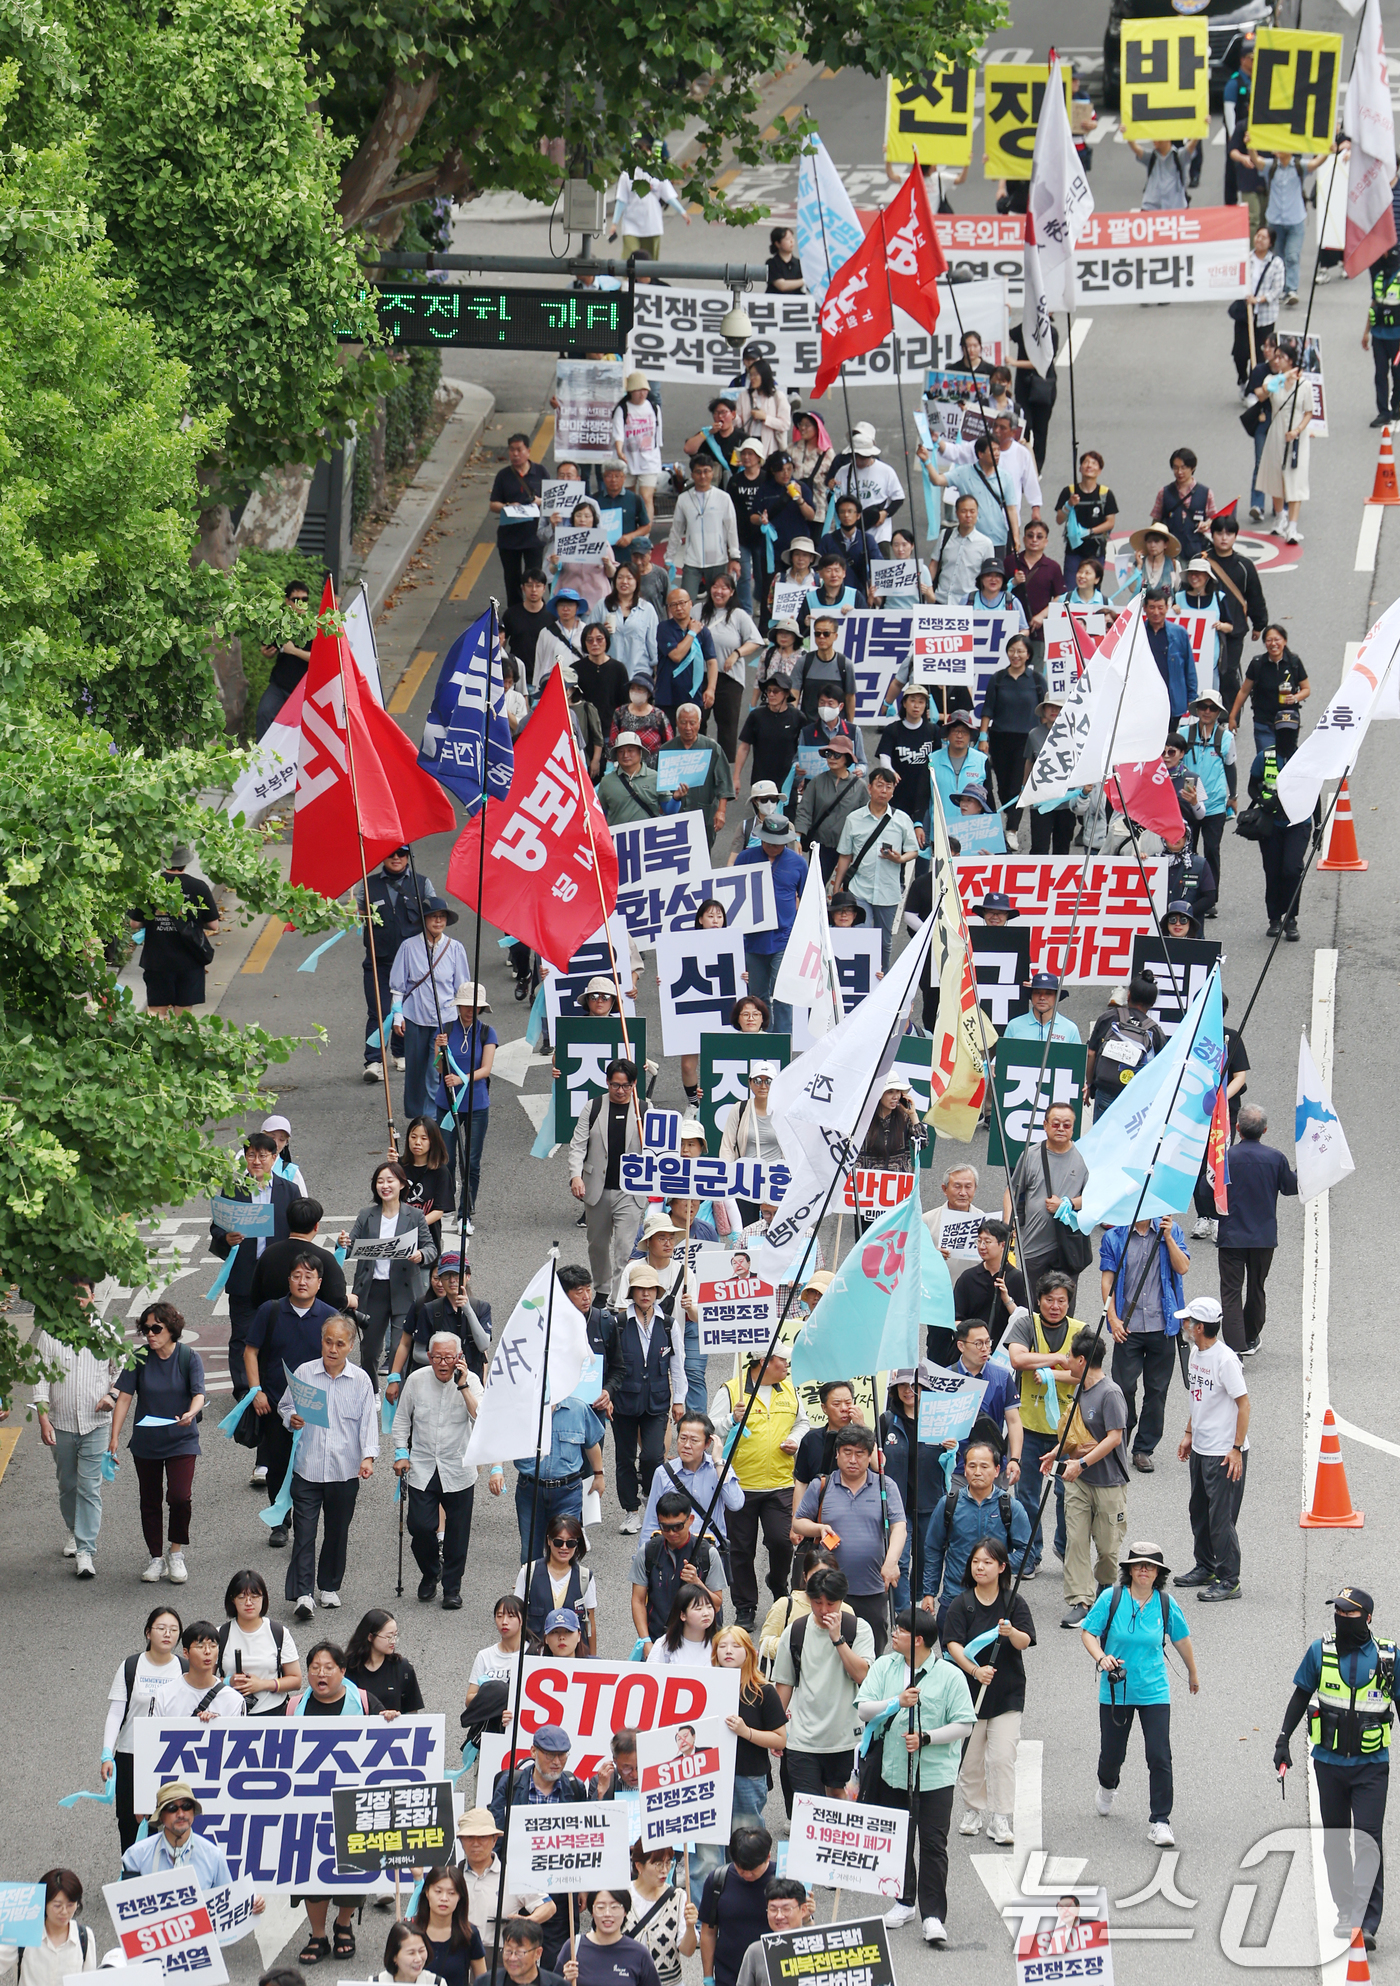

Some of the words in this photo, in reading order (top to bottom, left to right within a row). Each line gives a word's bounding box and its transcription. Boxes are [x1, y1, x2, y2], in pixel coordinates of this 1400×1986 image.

[1127, 36, 1204, 122] 반
[896, 62, 968, 136] 전
[1252, 48, 1336, 138] 대
[1107, 215, 1202, 242] 팔아먹는
[1077, 256, 1195, 292] 진하라!
[634, 293, 728, 333] 전쟁을
[749, 301, 822, 333] 부르
[632, 332, 777, 375] 윤석열은
[794, 334, 951, 376] 퇴하라!
[568, 432, 610, 445] 중단하라
[557, 531, 591, 546] 전쟁조장
[577, 543, 604, 556] 규탄!
[874, 563, 906, 580] 전쟁조장
[895, 571, 919, 588] 규탄!
[918, 618, 970, 631] 전쟁조장
[837, 617, 1006, 665] 대북단
[925, 636, 963, 654] STOP
[922, 658, 967, 673] 윤석열
[660, 751, 704, 769] 대북전단
[957, 864, 1158, 916] 전단살포
[617, 870, 764, 944] 확성기
[671, 953, 737, 1026] 석
[971, 951, 1020, 1026] 규
[1003, 1065, 1080, 1144] 장
[645, 1113, 678, 1150] 미
[844, 1171, 917, 1208] 반대
[382, 1243, 416, 1259] 규탄!
[672, 1242, 702, 1261] 조장
[940, 1237, 967, 1250] 윤석열
[714, 1279, 761, 1300] STOP
[702, 1304, 769, 1322] 전쟁조장
[703, 1328, 770, 1346] 대북전단
[928, 1375, 965, 1394] 쟁조장
[921, 1392, 974, 1416] 대북전단
[921, 1408, 975, 1427] 확성기방송
[920, 1426, 948, 1437] 중단!
[519, 1668, 708, 1736] STOP
[154, 1726, 436, 1800] 전쟁조장
[658, 1753, 708, 1786] STOP
[355, 1790, 390, 1811] 긴장
[394, 1787, 437, 1808] 격화!
[646, 1781, 716, 1813] 전쟁조장
[355, 1809, 391, 1831] 충돌
[394, 1806, 438, 1828] 조장!
[525, 1814, 610, 1832] 접경지역·NLL
[647, 1809, 717, 1841] 대북전단
[812, 1807, 864, 1830] 전쟁나면
[867, 1816, 897, 1834] 공멸!
[193, 1813, 405, 1886] 적대
[346, 1830, 403, 1855] 윤석열
[406, 1827, 445, 1850] 규탄
[531, 1832, 605, 1851] 포사격훈련
[806, 1826, 860, 1848] 9.19합의
[863, 1835, 892, 1852] 폐기
[387, 1855, 416, 1867] 겨레하나
[531, 1852, 602, 1872] 중단하라!
[815, 1846, 879, 1872] 규탄한다
[555, 1876, 582, 1885] 겨레하나
[836, 1873, 862, 1884] 겨레하나
[116, 1885, 198, 1922] 전쟁조장
[219, 1893, 256, 1932] 규탄!
[137, 1913, 197, 1953] STOP
[792, 1934, 825, 1955] 전쟁
[826, 1928, 863, 1950] 도발!
[1037, 1925, 1094, 1956] STOP
[780, 1944, 882, 1978] 대북전단살포
[1023, 1955, 1105, 1984] 전쟁조장
